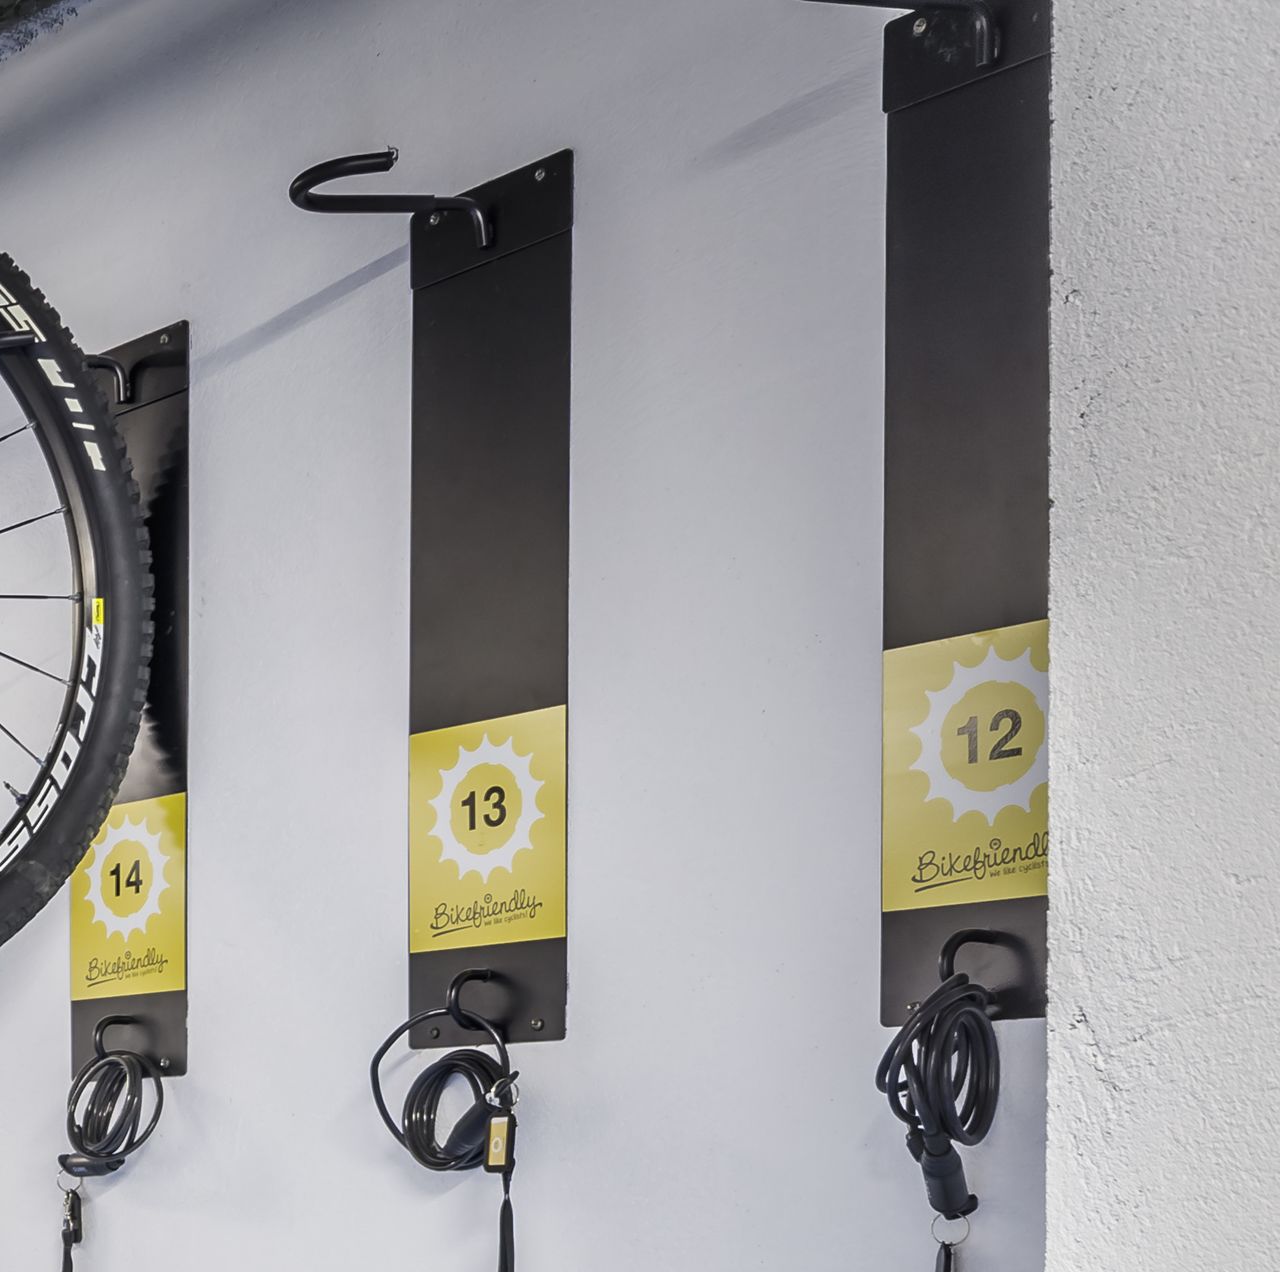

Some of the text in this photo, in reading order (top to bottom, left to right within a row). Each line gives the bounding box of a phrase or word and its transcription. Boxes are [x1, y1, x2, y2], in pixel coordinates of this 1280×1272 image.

[957, 709, 1022, 764] 12
[461, 786, 507, 831] 13
[109, 859, 143, 897] 14
[430, 889, 543, 930] Bikefriendly
[85, 947, 168, 981] Bikefriendly
